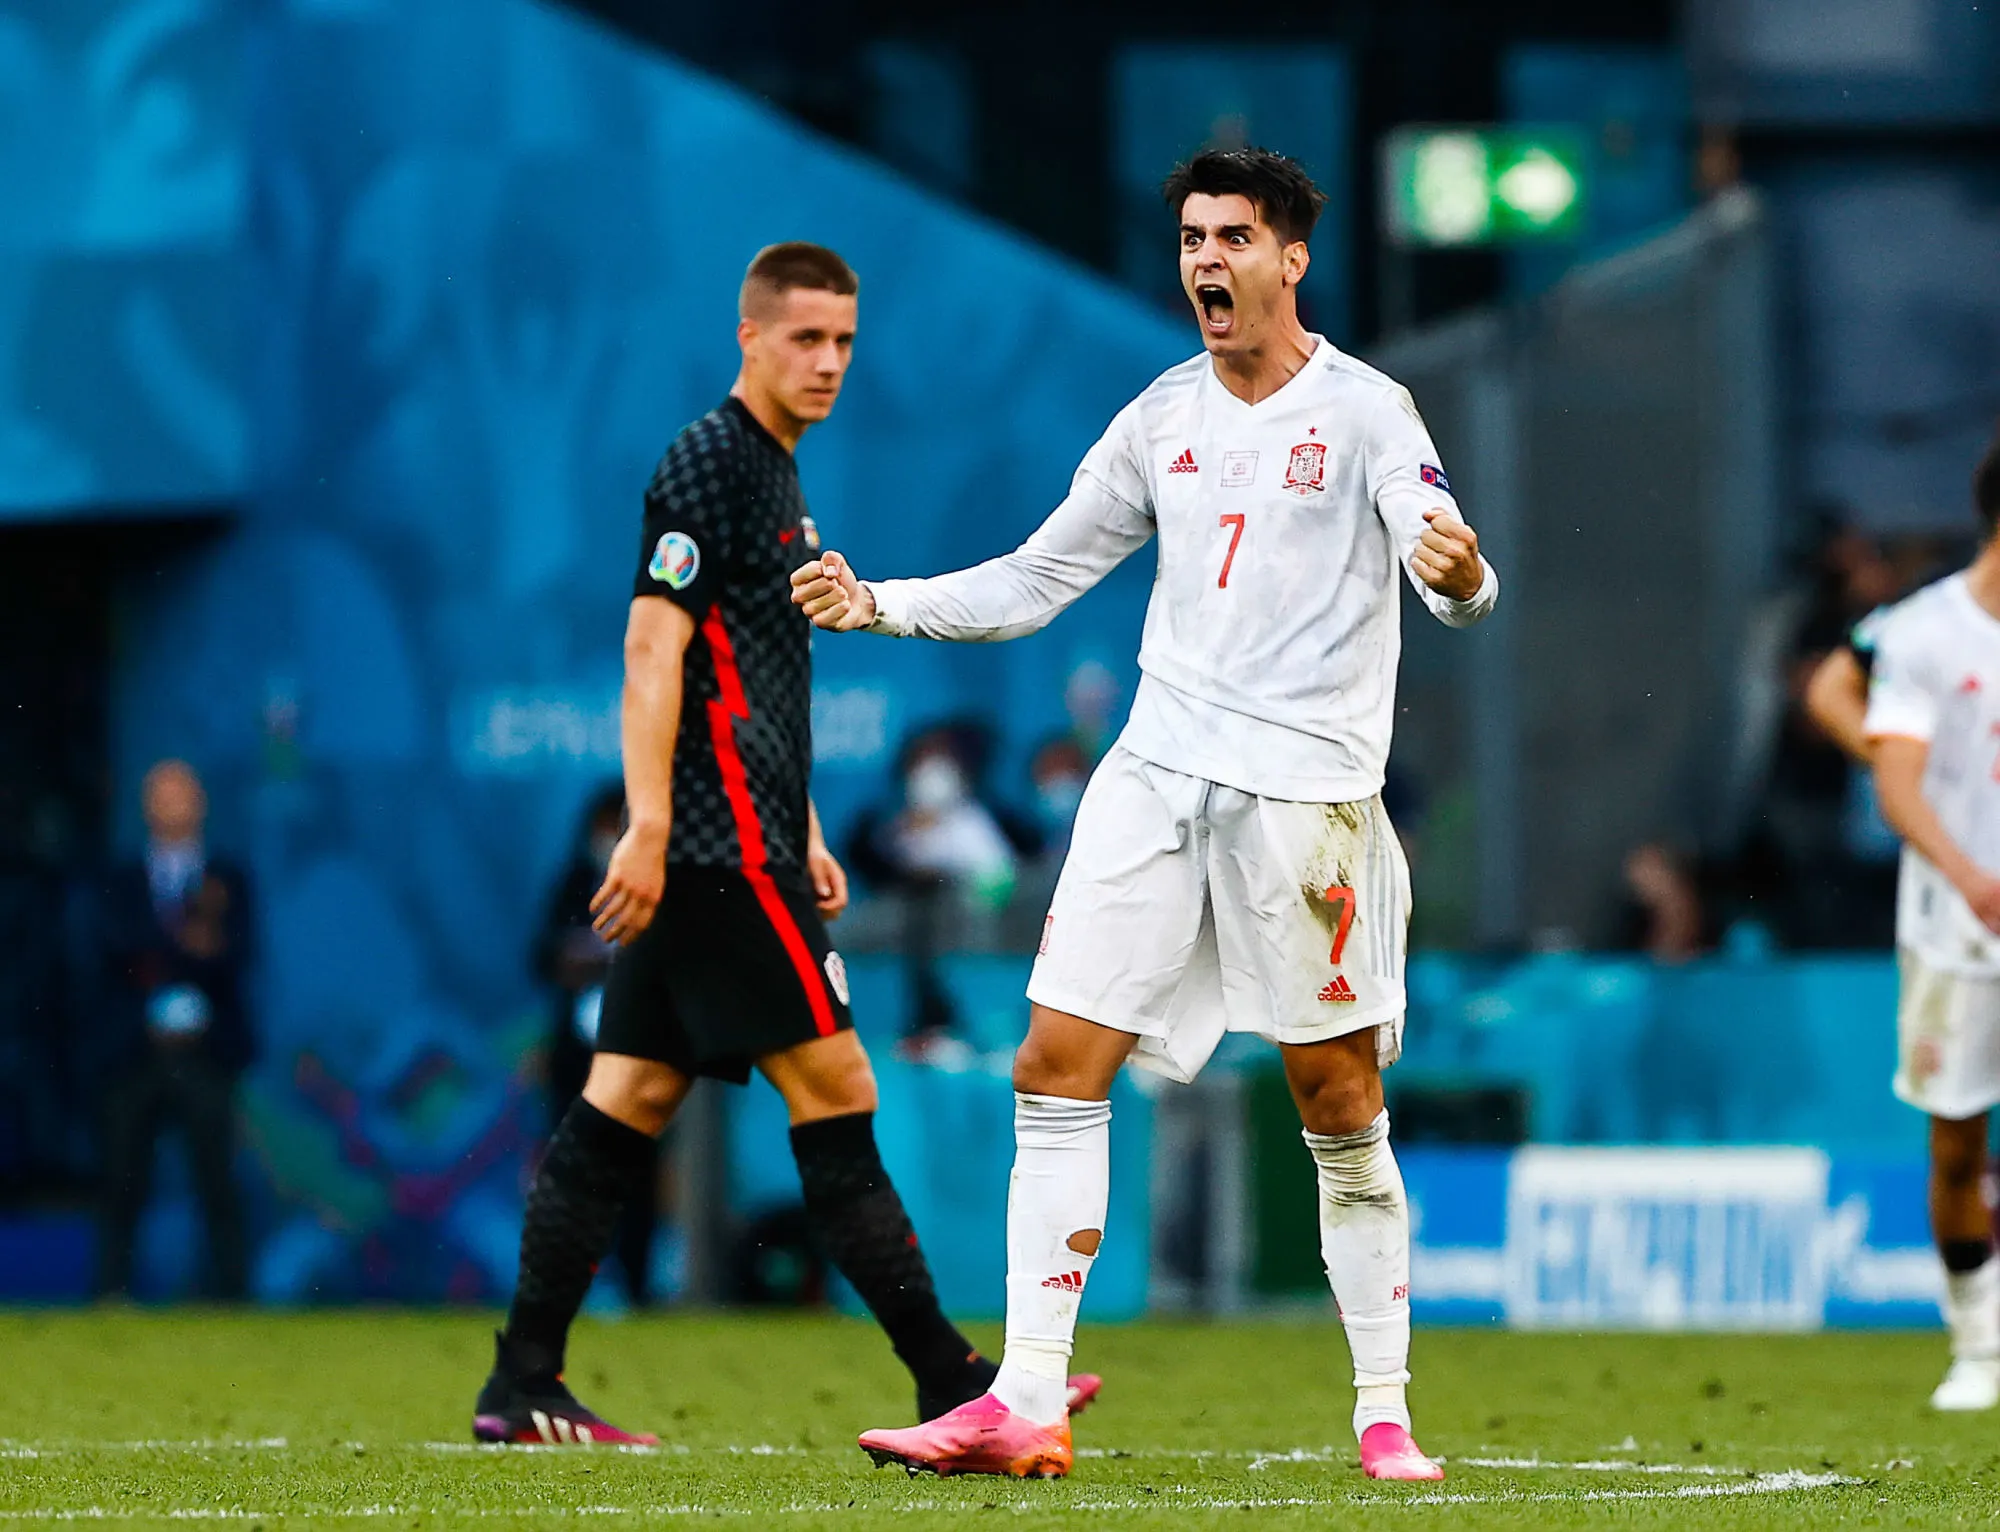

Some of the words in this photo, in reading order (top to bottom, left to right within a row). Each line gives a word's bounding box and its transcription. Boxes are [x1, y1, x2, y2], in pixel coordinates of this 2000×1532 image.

[1168, 465, 1199, 473] adidas
[1218, 513, 1245, 588] 7
[1325, 887, 1355, 965] 7
[1317, 991, 1357, 1002] adidas
[1392, 1283, 1409, 1301] RF
